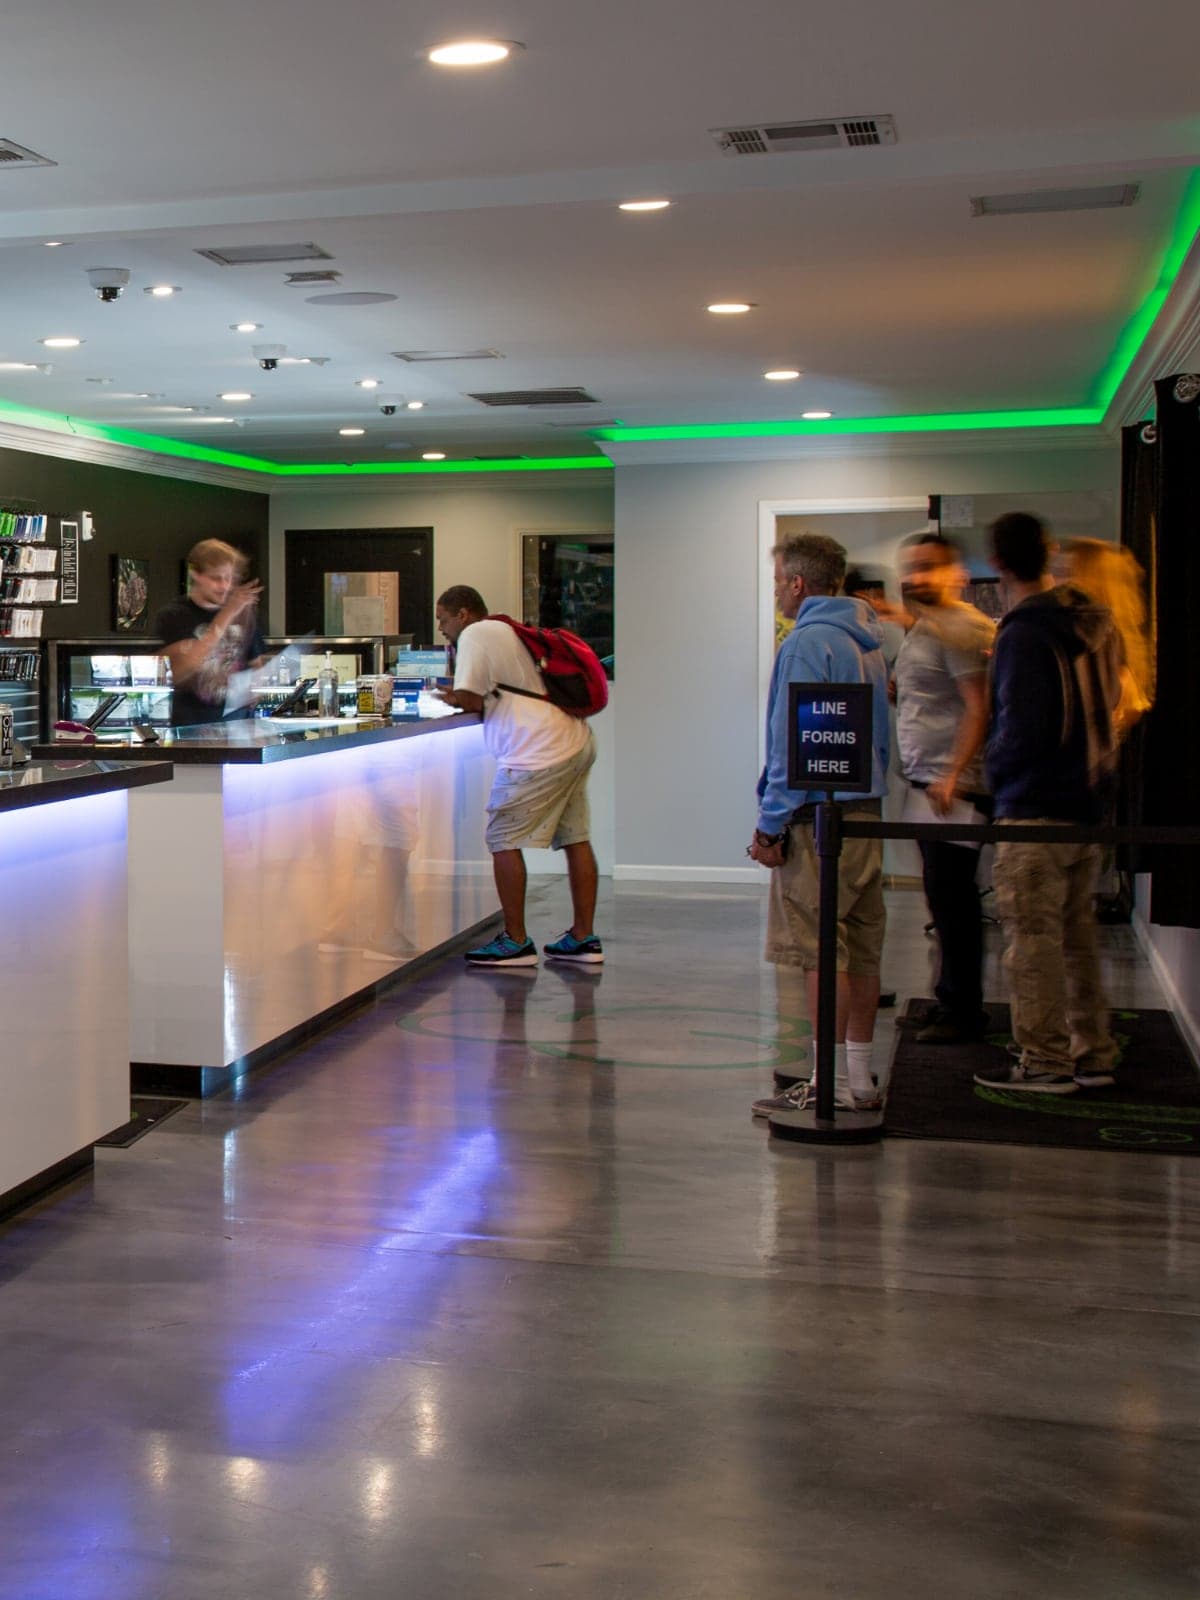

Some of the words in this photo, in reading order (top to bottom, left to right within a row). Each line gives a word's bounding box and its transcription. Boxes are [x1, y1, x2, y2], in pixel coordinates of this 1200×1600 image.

[812, 701, 847, 715] LINE
[801, 730, 857, 745] FORMS
[807, 760, 850, 774] HERE
